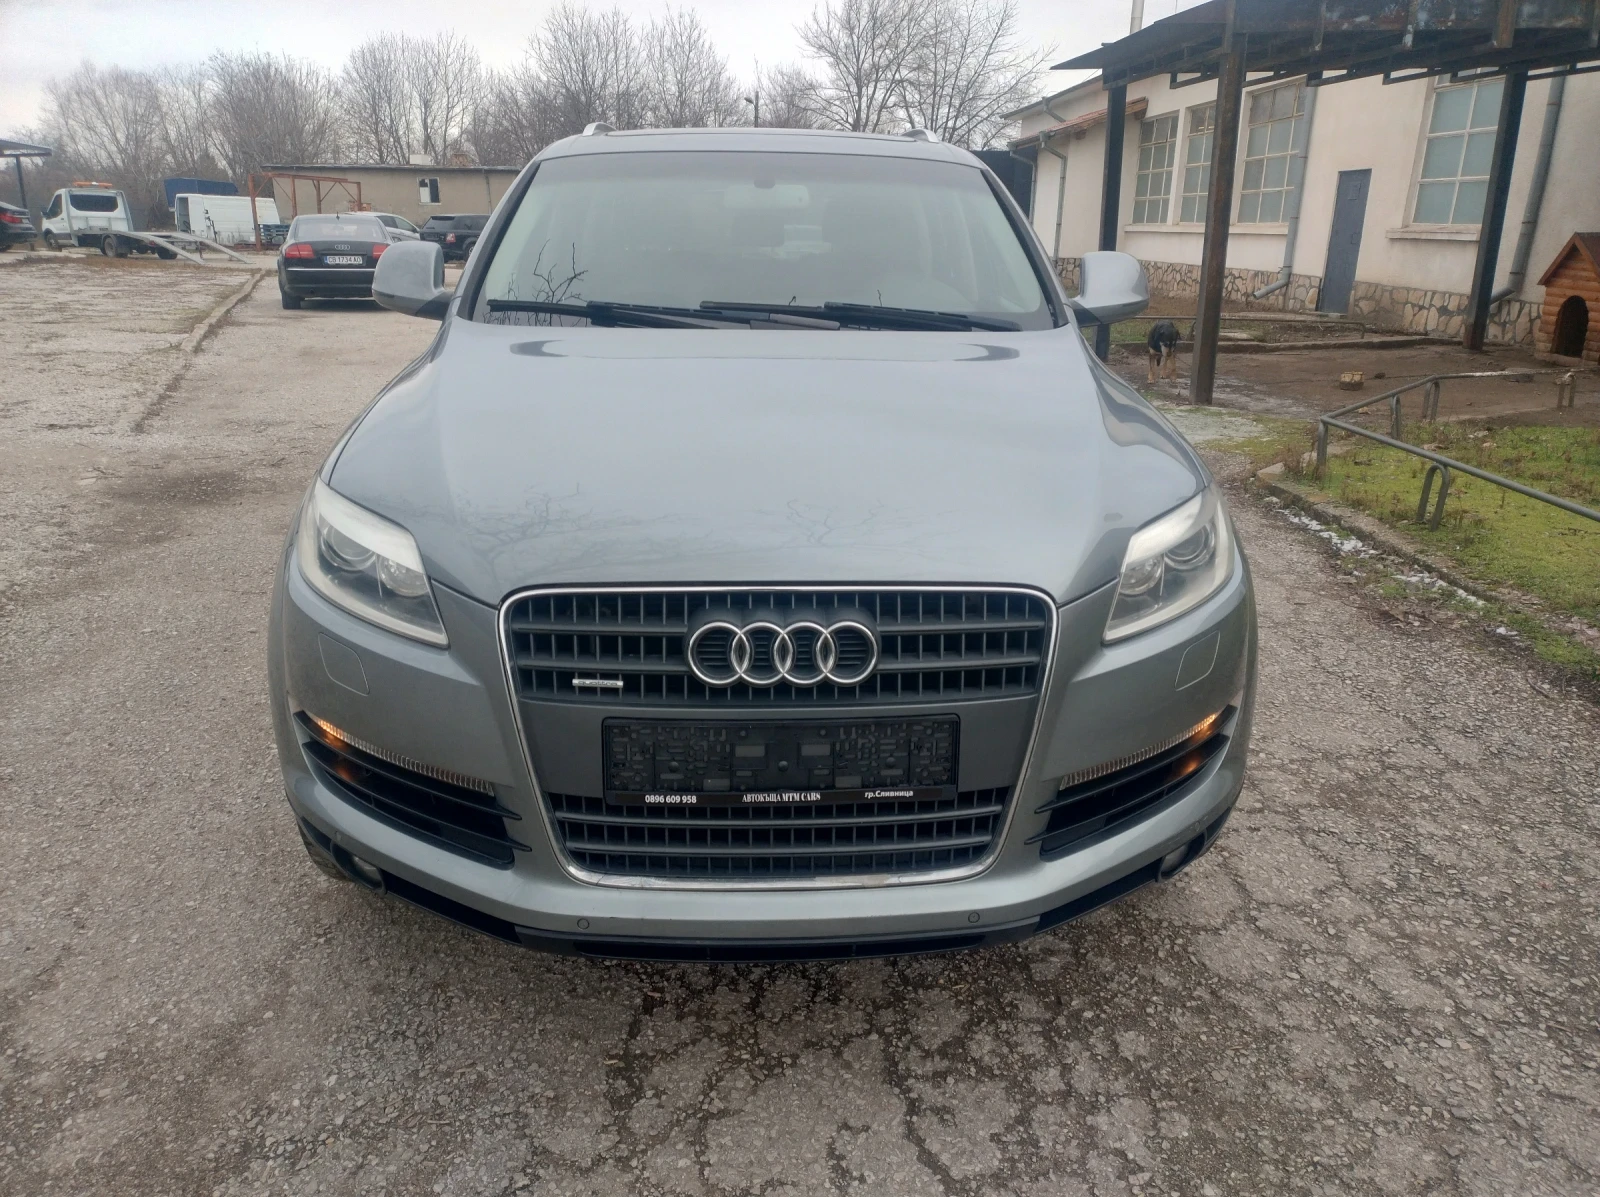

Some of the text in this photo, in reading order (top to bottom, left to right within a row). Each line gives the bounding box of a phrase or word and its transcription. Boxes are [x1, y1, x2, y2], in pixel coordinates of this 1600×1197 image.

[645, 794, 697, 803] 0896 609 958
[742, 793, 780, 803] АВТОКЪЩА
[801, 792, 821, 801] CARS
